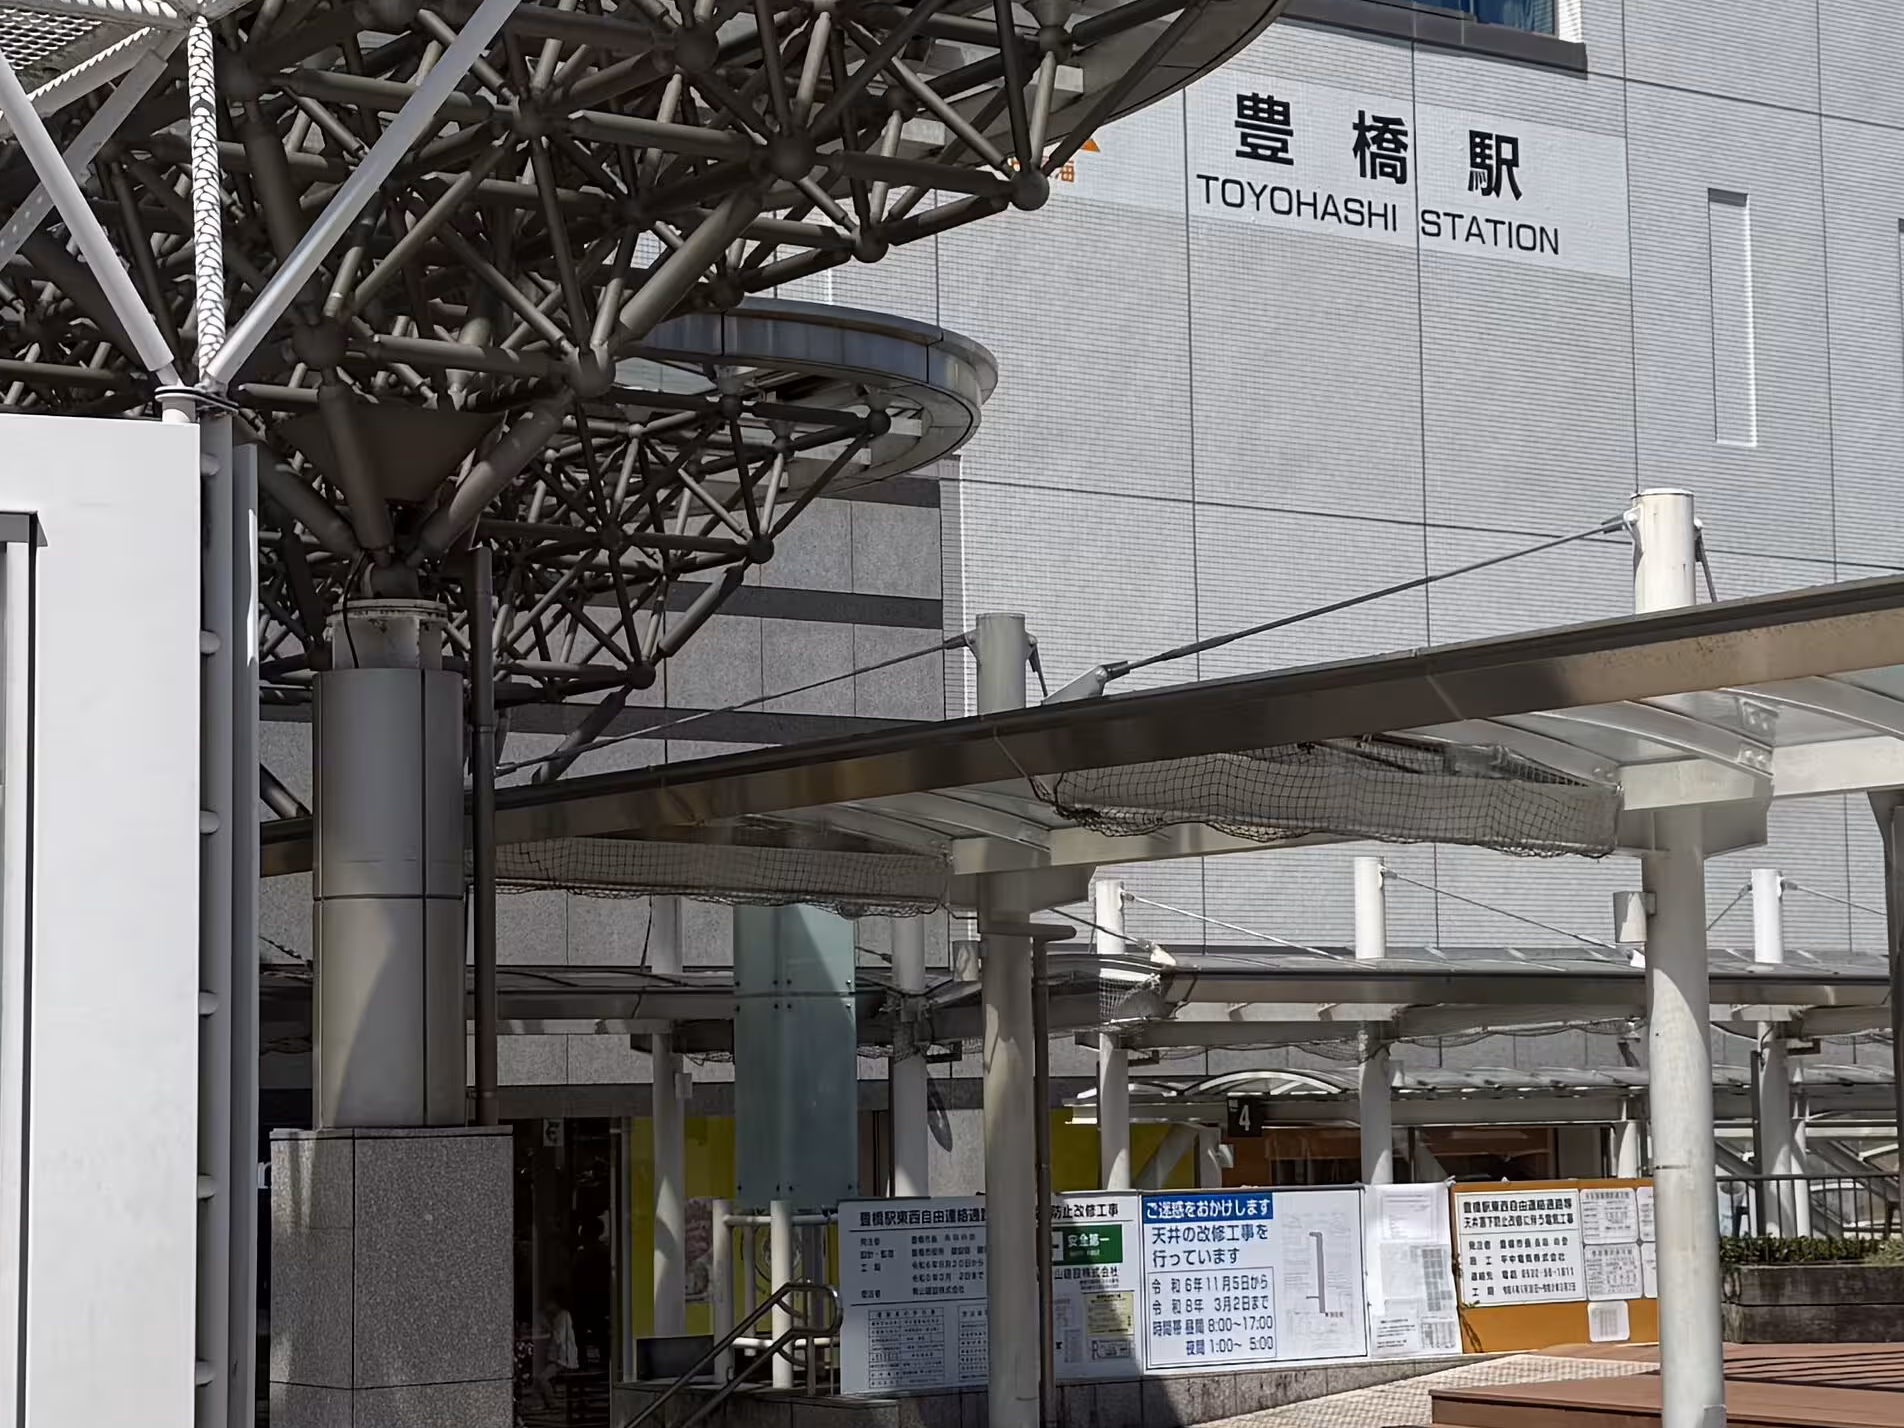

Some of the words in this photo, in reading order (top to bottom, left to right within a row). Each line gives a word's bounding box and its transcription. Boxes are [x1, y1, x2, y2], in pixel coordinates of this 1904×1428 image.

[1234, 92, 1523, 202] 豊橋駅
[1196, 173, 1398, 232] TOYOHASHI
[1420, 209, 1560, 256] STATION
[1238, 1104, 1251, 1132] 4
[1146, 1198, 1271, 1220] ご迷惑をおかけします
[1067, 1233, 1110, 1247] 安全第一
[1152, 1224, 1269, 1245] 天井の改修工事を
[1152, 1247, 1240, 1269] 行っています
